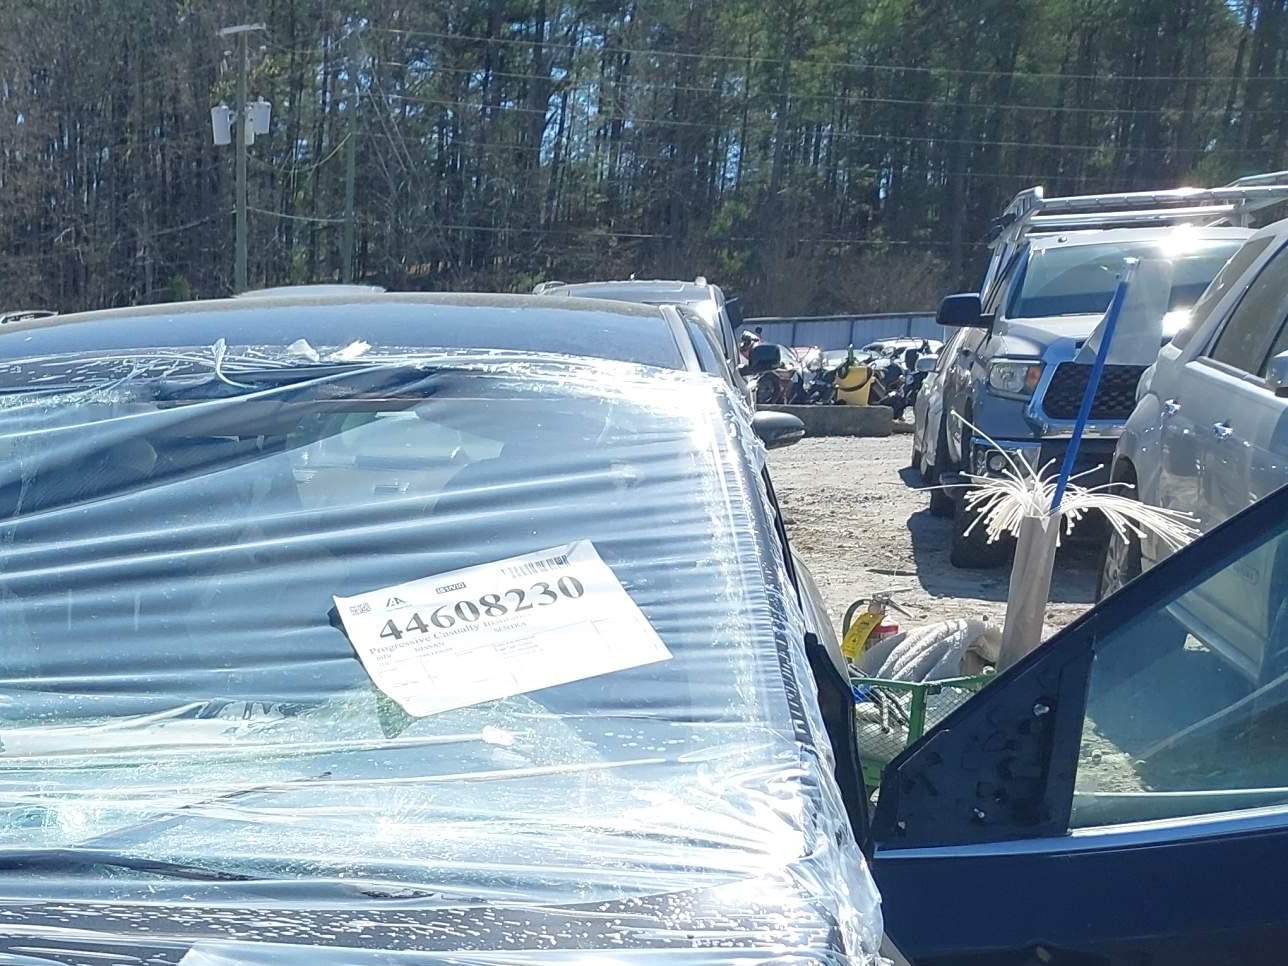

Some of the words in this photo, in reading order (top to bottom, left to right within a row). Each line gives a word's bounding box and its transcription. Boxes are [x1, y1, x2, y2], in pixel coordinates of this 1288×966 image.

[379, 575, 585, 641] 44608230
[368, 634, 431, 656] Progressive
[433, 621, 482, 640] Casualty
